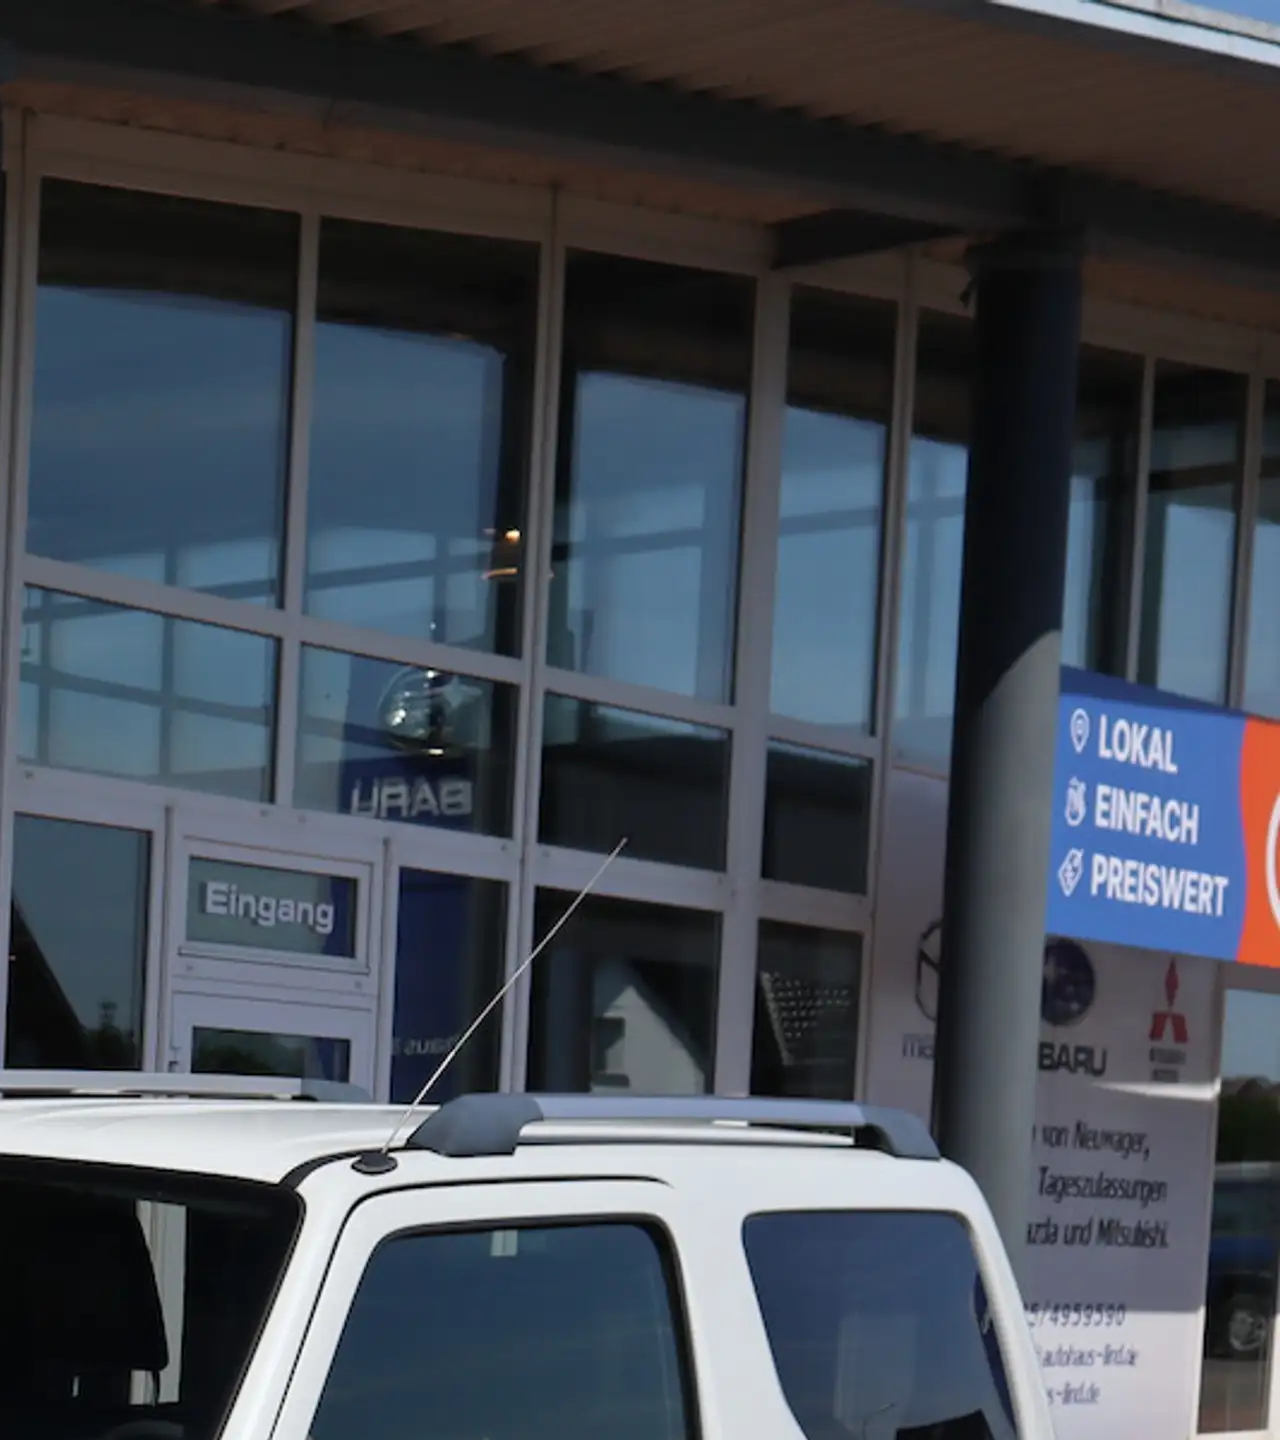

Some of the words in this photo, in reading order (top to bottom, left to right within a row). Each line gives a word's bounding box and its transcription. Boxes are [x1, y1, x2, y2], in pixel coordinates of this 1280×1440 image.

[1097, 713, 1179, 774] LOKAL
[1094, 783, 1200, 845] EINFACH
[203, 880, 336, 935] Eingang
[1090, 852, 1230, 918] PREISWERT
[1037, 1041, 1108, 1078] BARU
[1062, 1214, 1094, 1246] und
